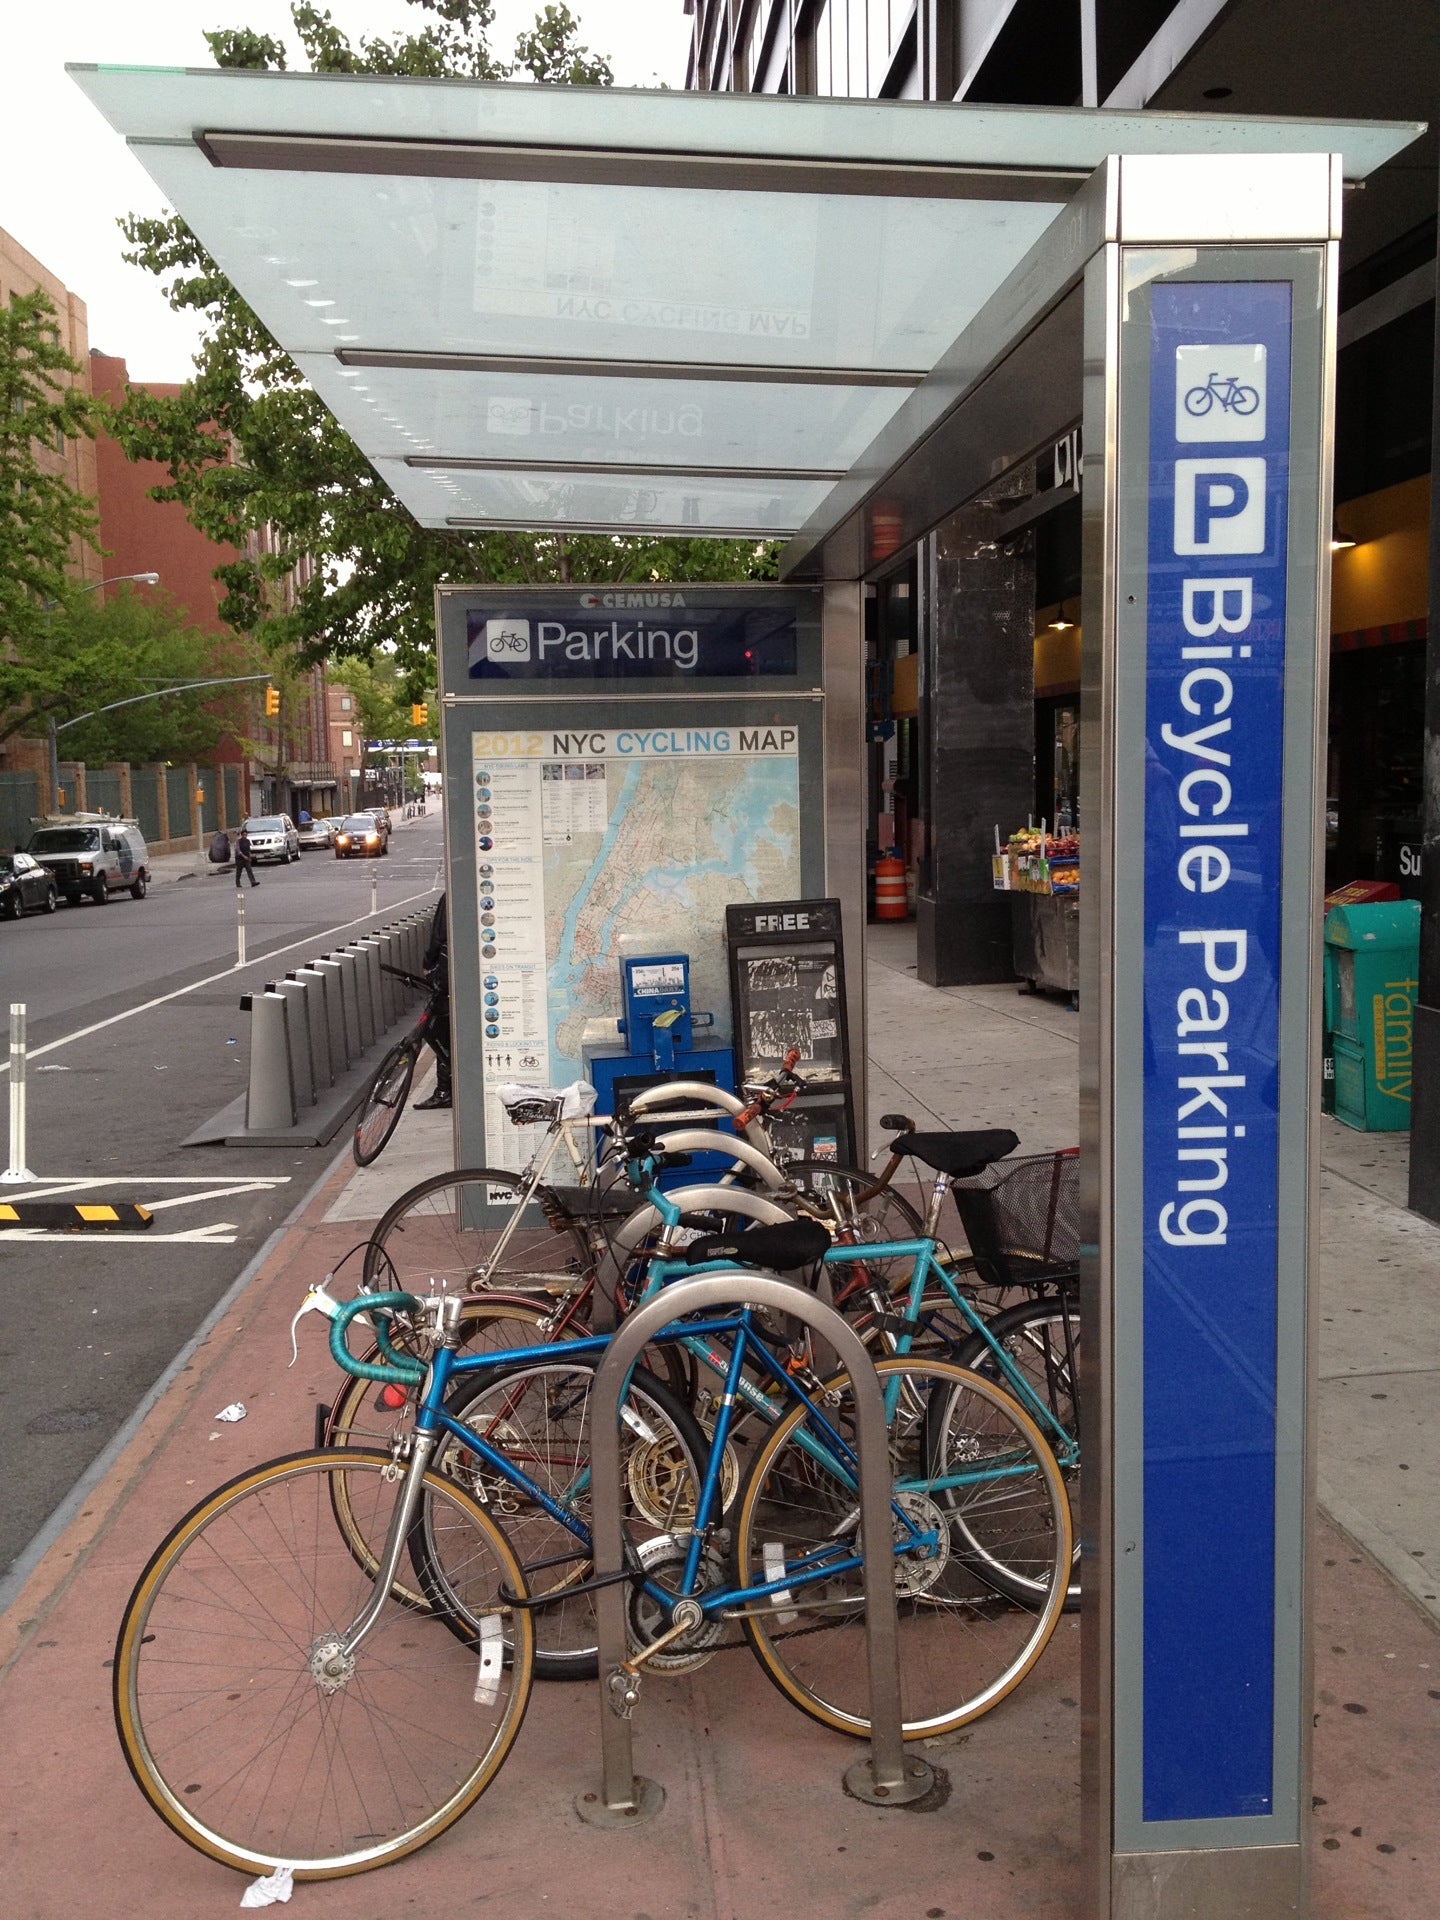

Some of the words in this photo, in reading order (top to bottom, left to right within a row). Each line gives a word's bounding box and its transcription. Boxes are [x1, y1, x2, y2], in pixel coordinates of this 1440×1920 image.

[1193, 473, 1249, 544] P
[602, 592, 686, 608] CEMUSA
[538, 621, 698, 669] Parking
[474, 735, 544, 756] 2012
[553, 733, 606, 754] NYC
[616, 730, 731, 753] CYCLING
[739, 730, 795, 750] MAP
[1161, 576, 1254, 893] Bicycle
[755, 912, 810, 933] FREE
[1158, 929, 1249, 1246] Parking
[490, 1191, 512, 1200] NYC
